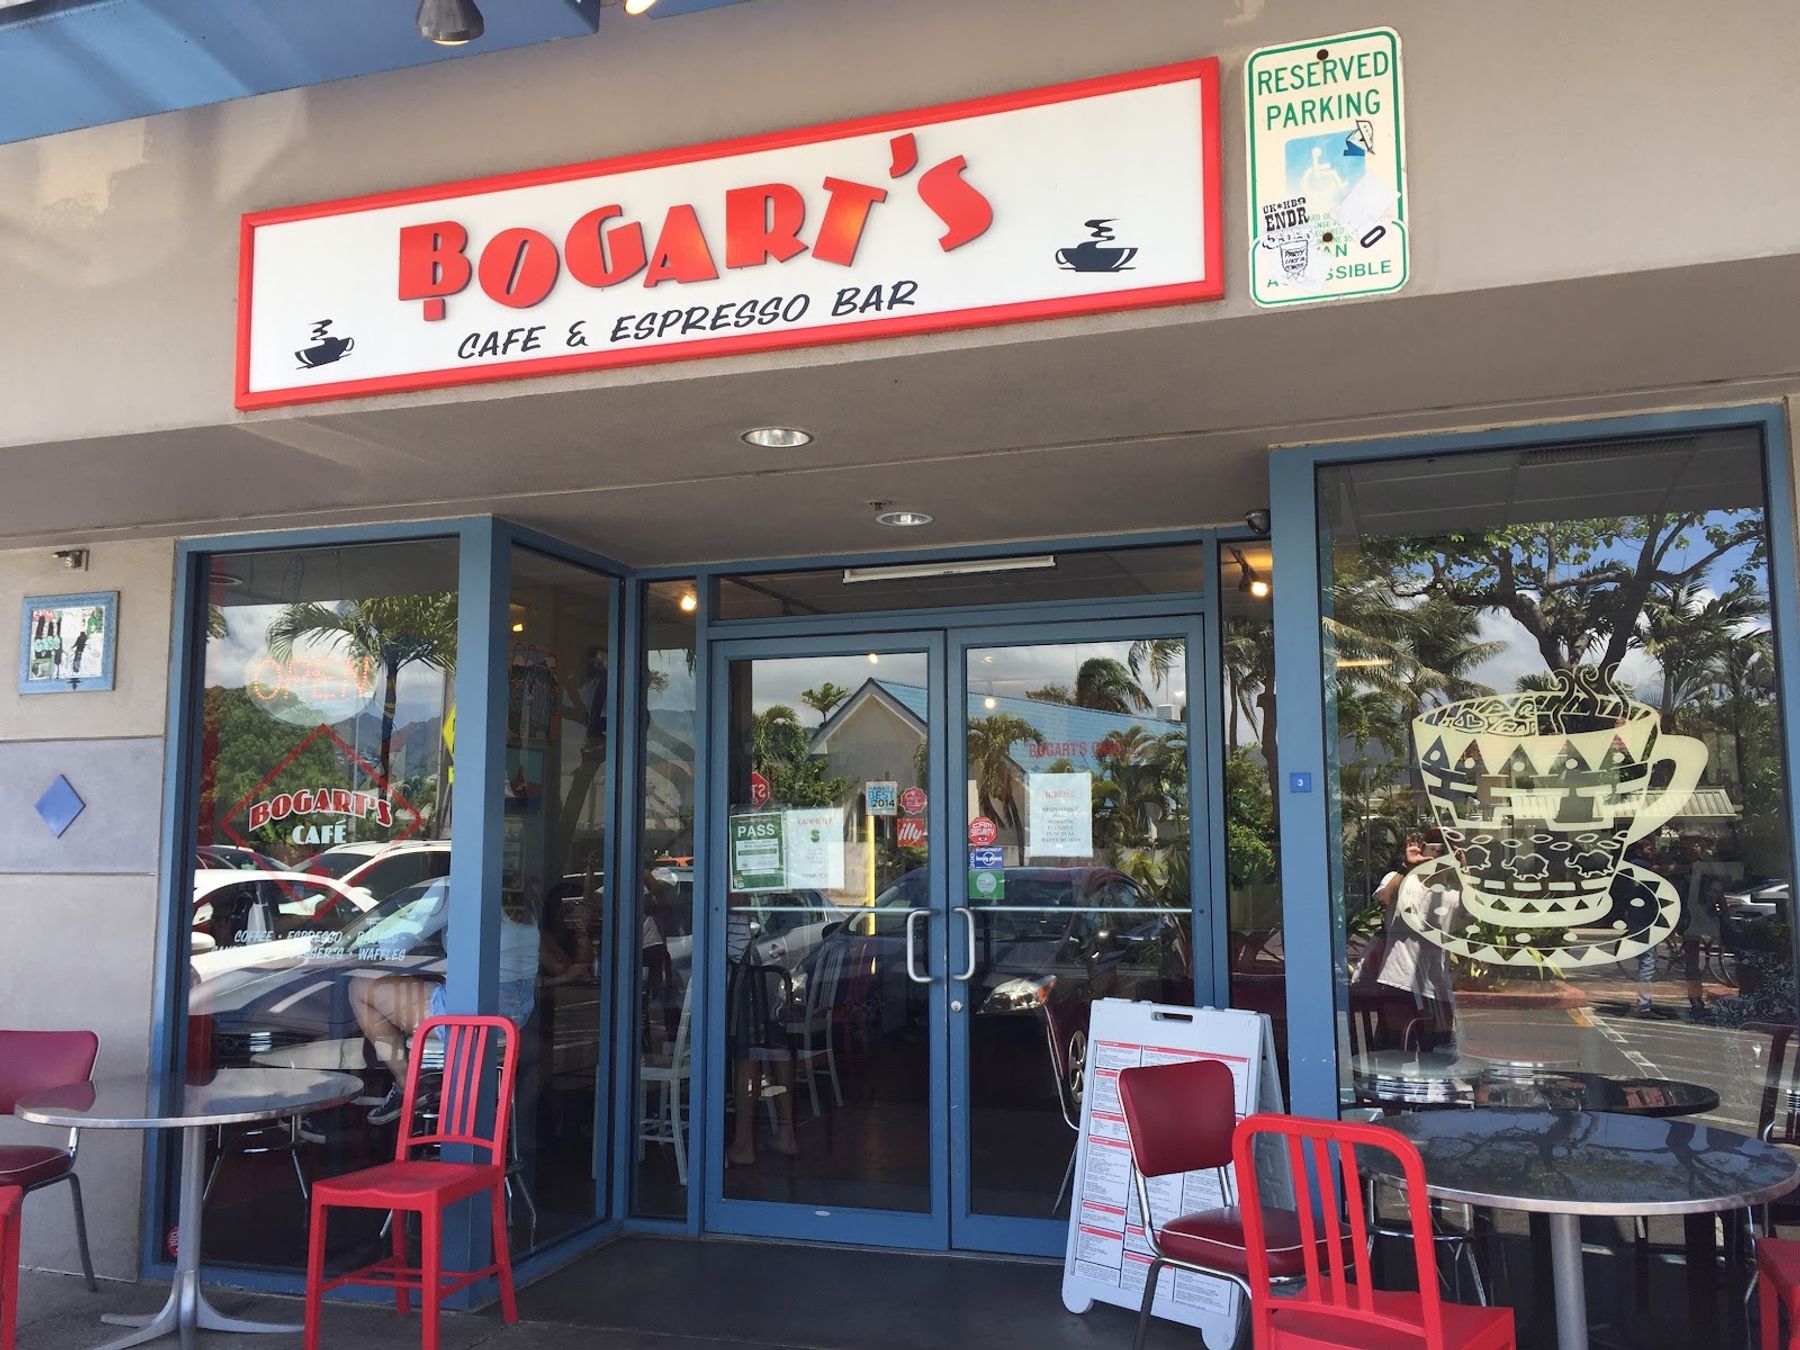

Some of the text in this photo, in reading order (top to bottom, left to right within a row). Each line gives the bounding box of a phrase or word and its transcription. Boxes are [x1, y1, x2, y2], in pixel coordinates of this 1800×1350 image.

[1257, 50, 1389, 96] RESERVED
[1266, 88, 1381, 131] PARKING
[398, 132, 993, 322] BOGART'S
[457, 280, 918, 360] CAFE & ESPRESSO BAR
[254, 655, 370, 700] OPEN
[868, 790, 895, 799] BEST
[872, 799, 895, 807] 2014
[248, 787, 393, 832] BOGART'S
[291, 819, 347, 845] CAFÉ
[737, 823, 776, 838] PASS
[897, 823, 922, 844] illy
[234, 930, 272, 943] COFFEE
[358, 948, 406, 960] WAFFLES
